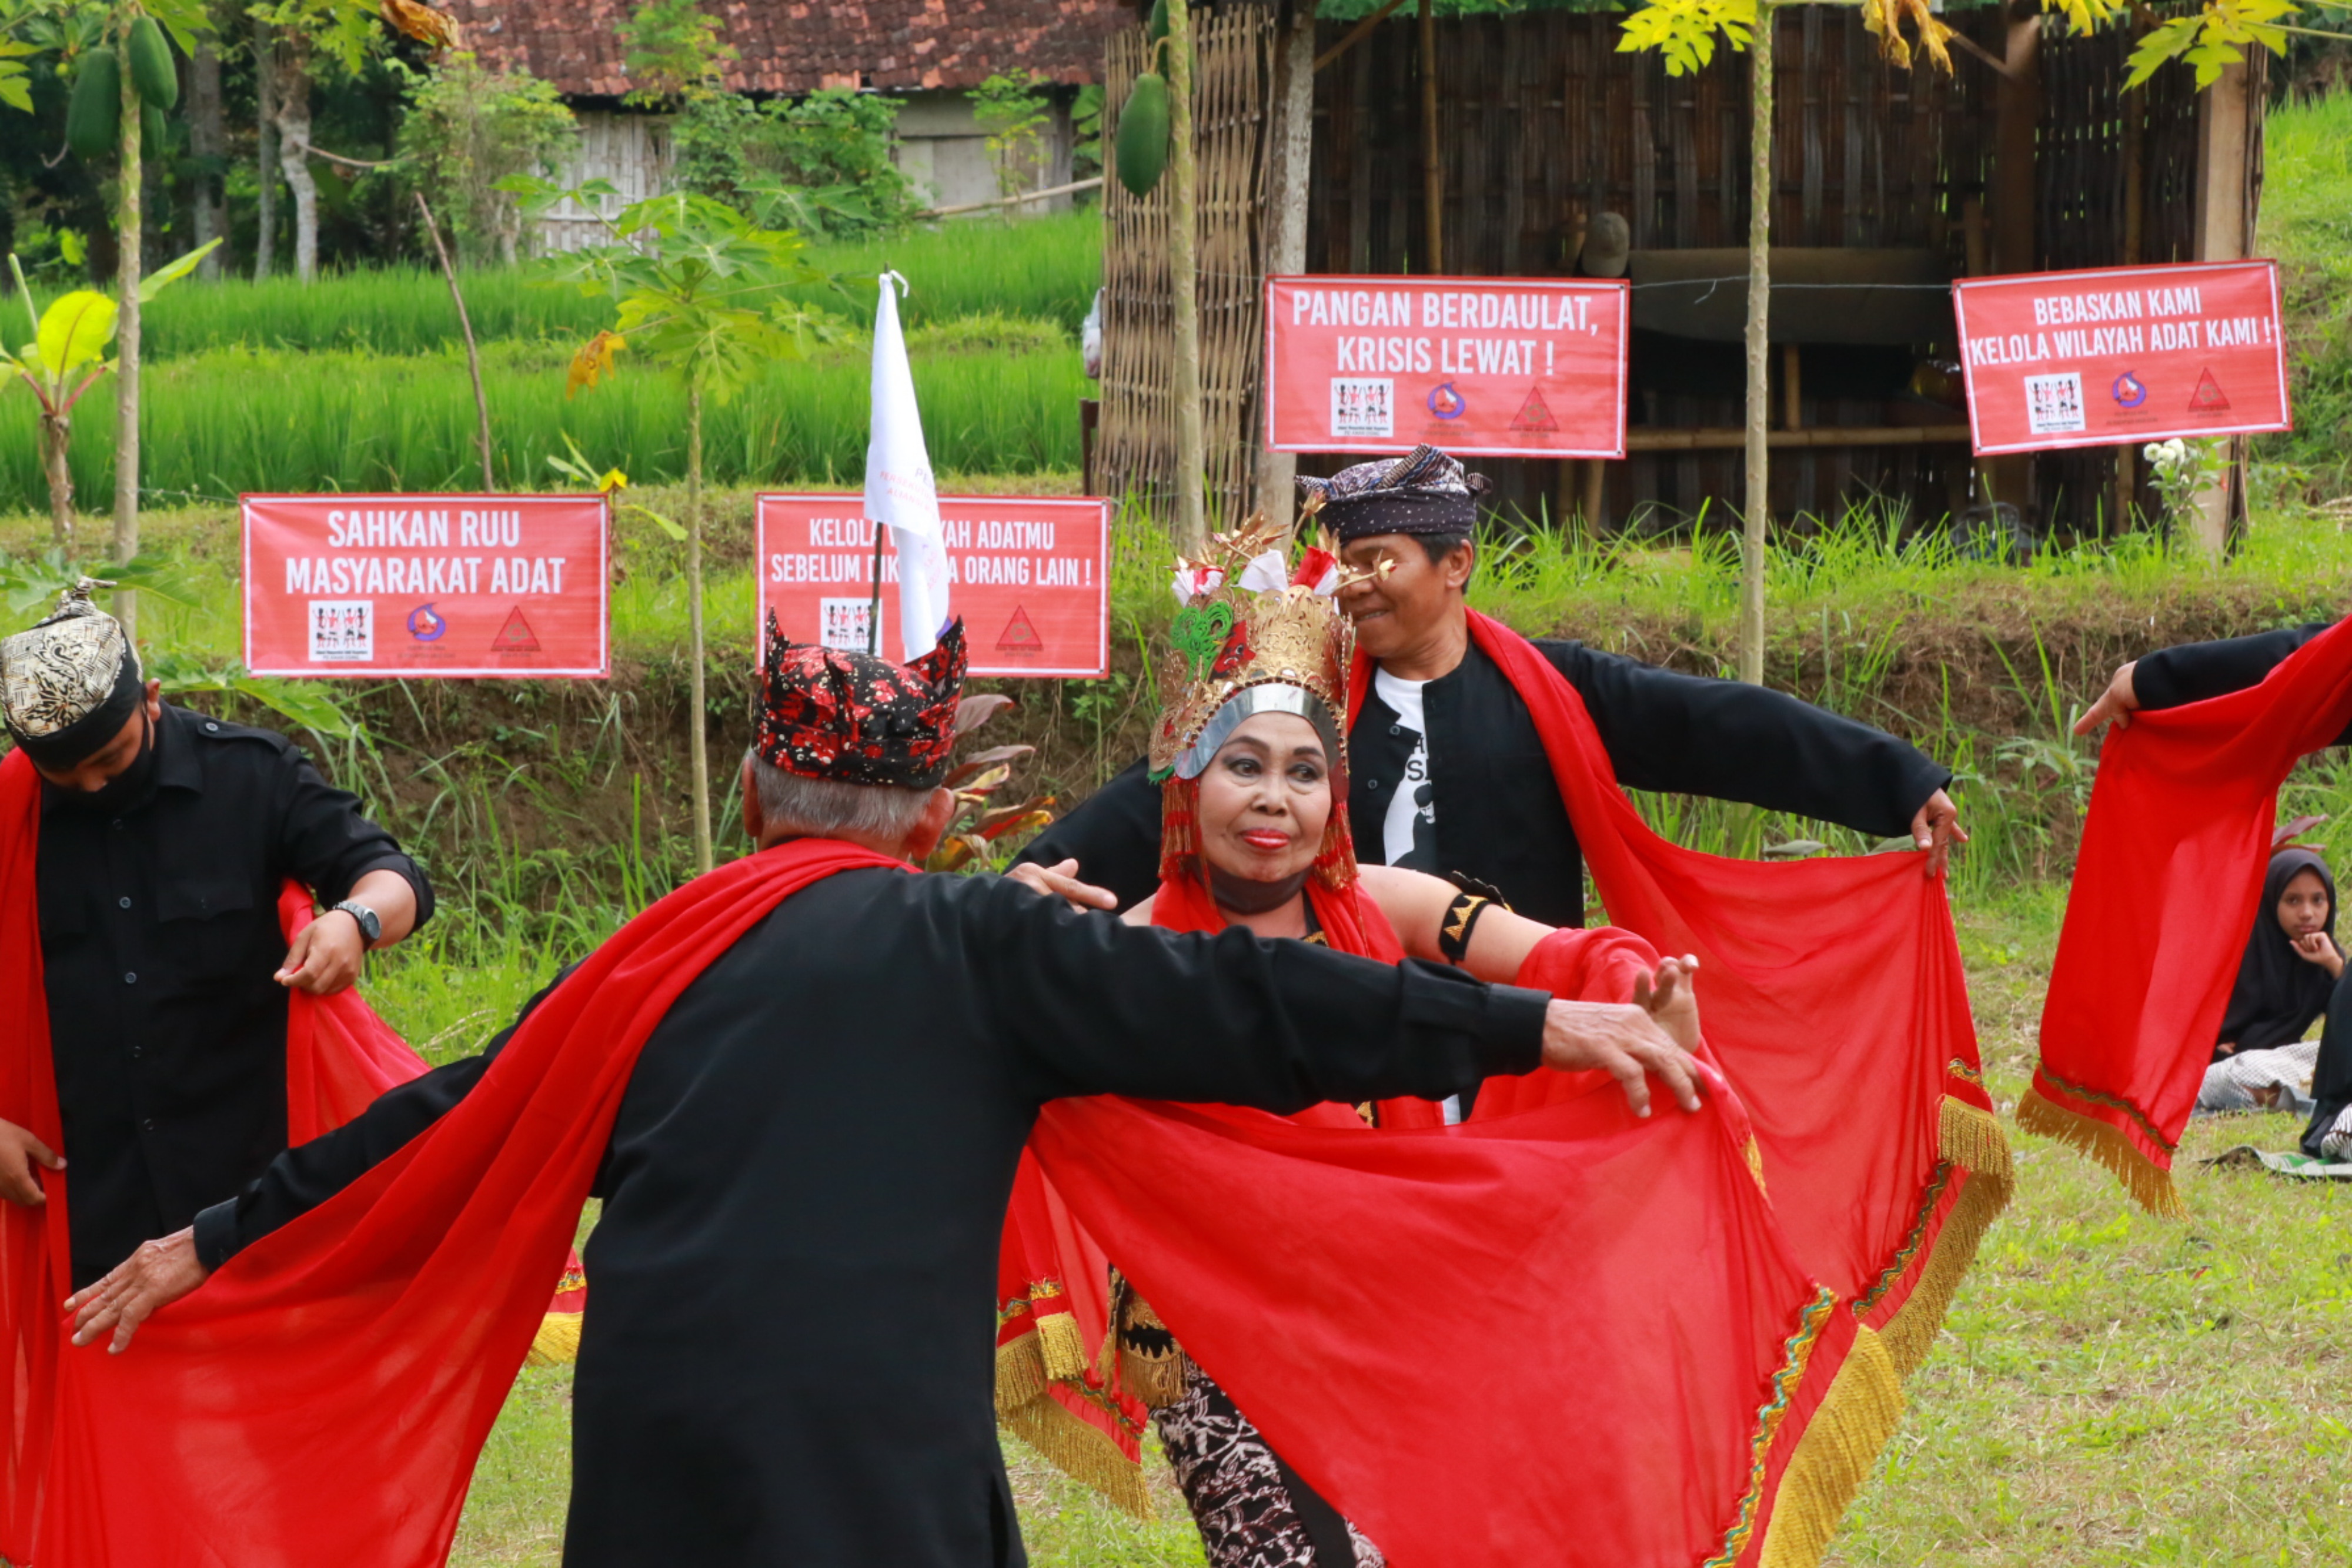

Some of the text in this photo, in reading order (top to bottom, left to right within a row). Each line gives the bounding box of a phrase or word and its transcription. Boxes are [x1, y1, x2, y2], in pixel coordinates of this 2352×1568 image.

[1293, 289, 1599, 336] PANGAN BERDAULAT,
[2033, 286, 2201, 326] BEBASKAN KAMI
[1337, 335, 1554, 376] KRISIS LEWAT !
[1970, 316, 2271, 366] KELOLA WILAYAH ADAT KAMI !
[327, 510, 520, 548] SAHKAN RUU
[976, 520, 1054, 550] ADATMU
[286, 556, 566, 594] MASYARAKAT ADAT
[771, 553, 860, 583] SEBELUM
[964, 555, 1030, 586] ORANG
[1035, 557, 1079, 586] LAIN
[1085, 559, 1091, 587] !
